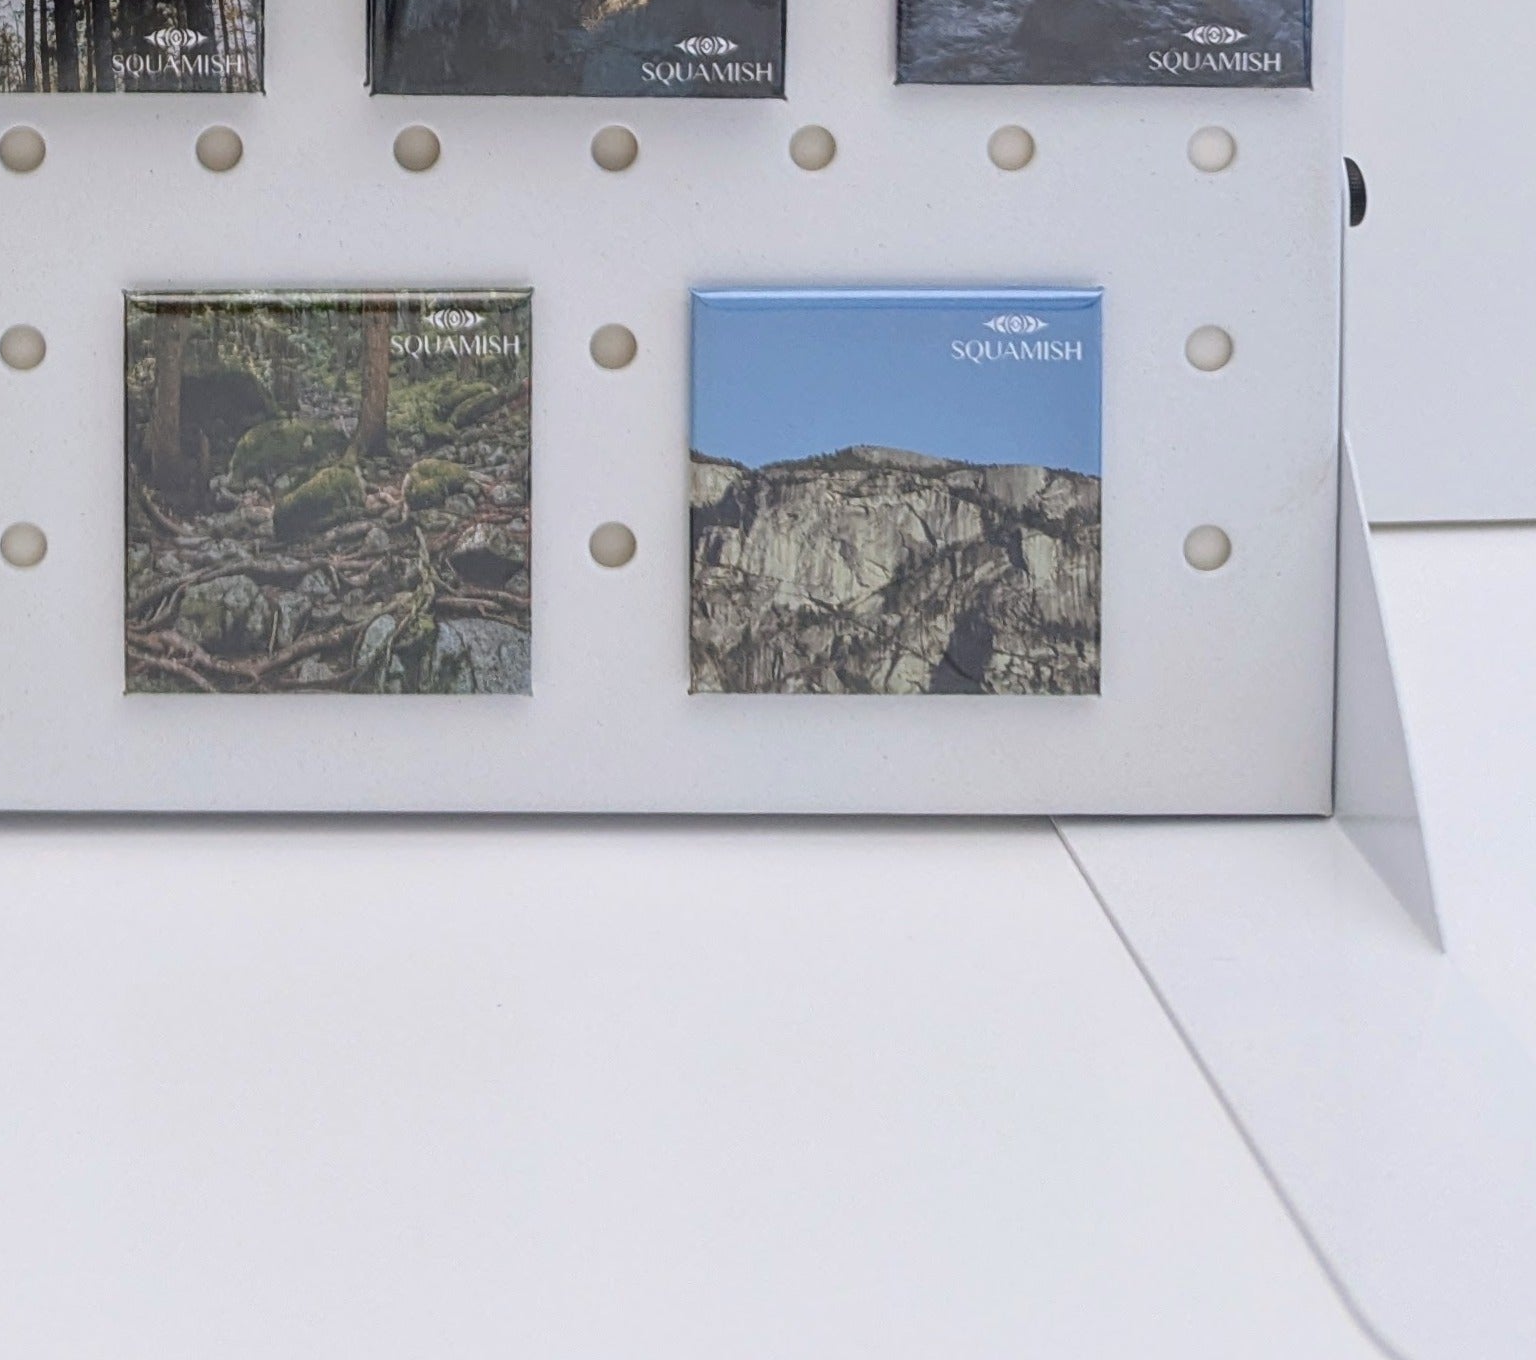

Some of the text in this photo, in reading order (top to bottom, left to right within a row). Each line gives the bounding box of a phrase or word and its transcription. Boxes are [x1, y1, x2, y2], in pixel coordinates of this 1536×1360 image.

[111, 54, 243, 78] SQUAMISH
[641, 62, 773, 86] SQUAMISH
[1148, 50, 1281, 75] SQUAMISH
[390, 334, 520, 359] SQUAMISH
[951, 339, 1083, 365] SQUAMISH
